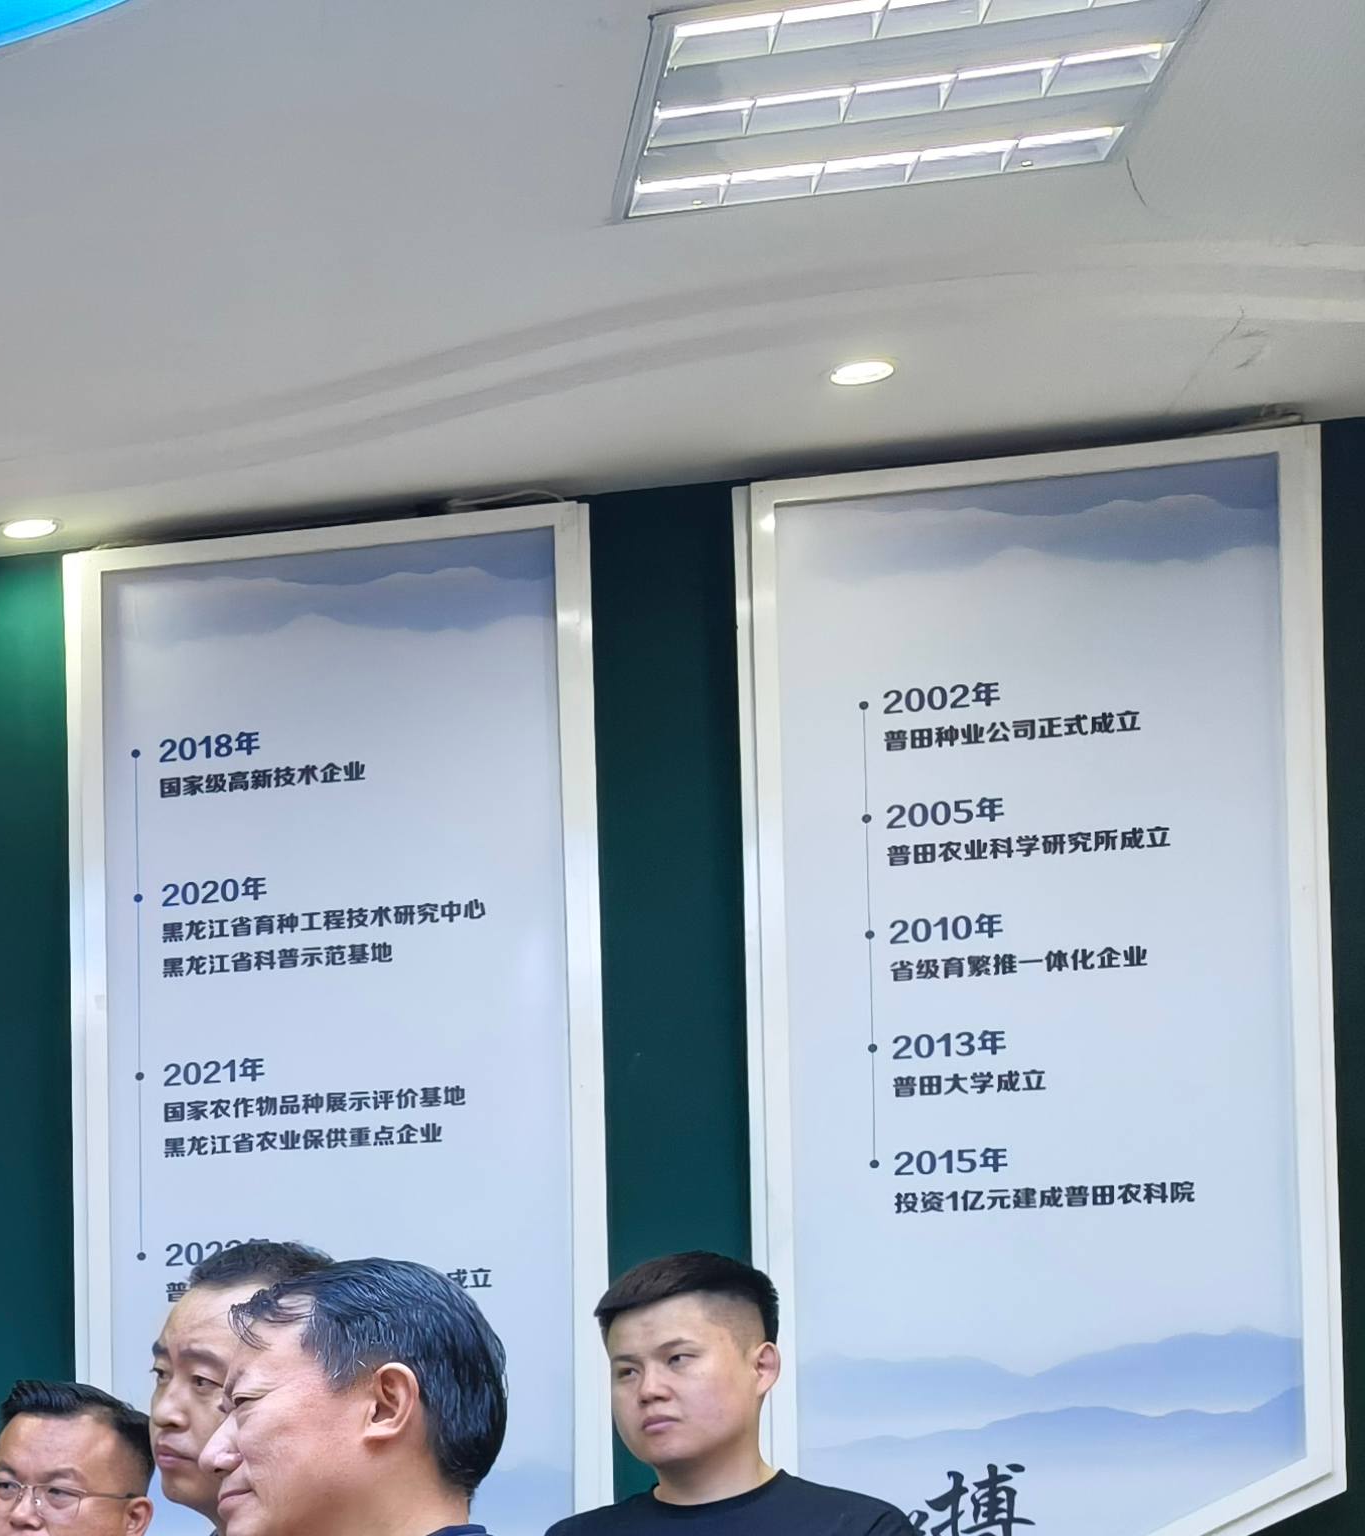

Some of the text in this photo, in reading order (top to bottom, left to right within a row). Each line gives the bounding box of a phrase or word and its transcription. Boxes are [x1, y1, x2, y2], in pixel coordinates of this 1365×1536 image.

[883, 682, 1000, 715] 2002年
[159, 731, 260, 764] 2018年
[884, 710, 1141, 752] 普田种业公司正式成立
[160, 761, 366, 799] 国家级高新技术企业
[886, 797, 1005, 830] 2005年
[887, 826, 1171, 867] 普田农业科学研究所成立
[161, 876, 267, 907] 2020年
[162, 898, 486, 943] 黑龙江省育种工程技术研究中心
[889, 913, 1004, 945] 2010年
[162, 942, 393, 978] 黑龙江省科普示范基地
[890, 946, 1148, 983] 省级育繁推一体化企业
[892, 1030, 1007, 1061] 2013年
[163, 1057, 265, 1087] 2021年
[892, 1069, 1046, 1098] 普田大学成立
[163, 1085, 466, 1123] 国家农作物品种展示评价基地
[164, 1122, 442, 1158] 黑龙江省农业保供重点企业
[894, 1147, 1008, 1176] 2015年
[894, 1181, 1195, 1214] 投资1亿元建成普田农科院
